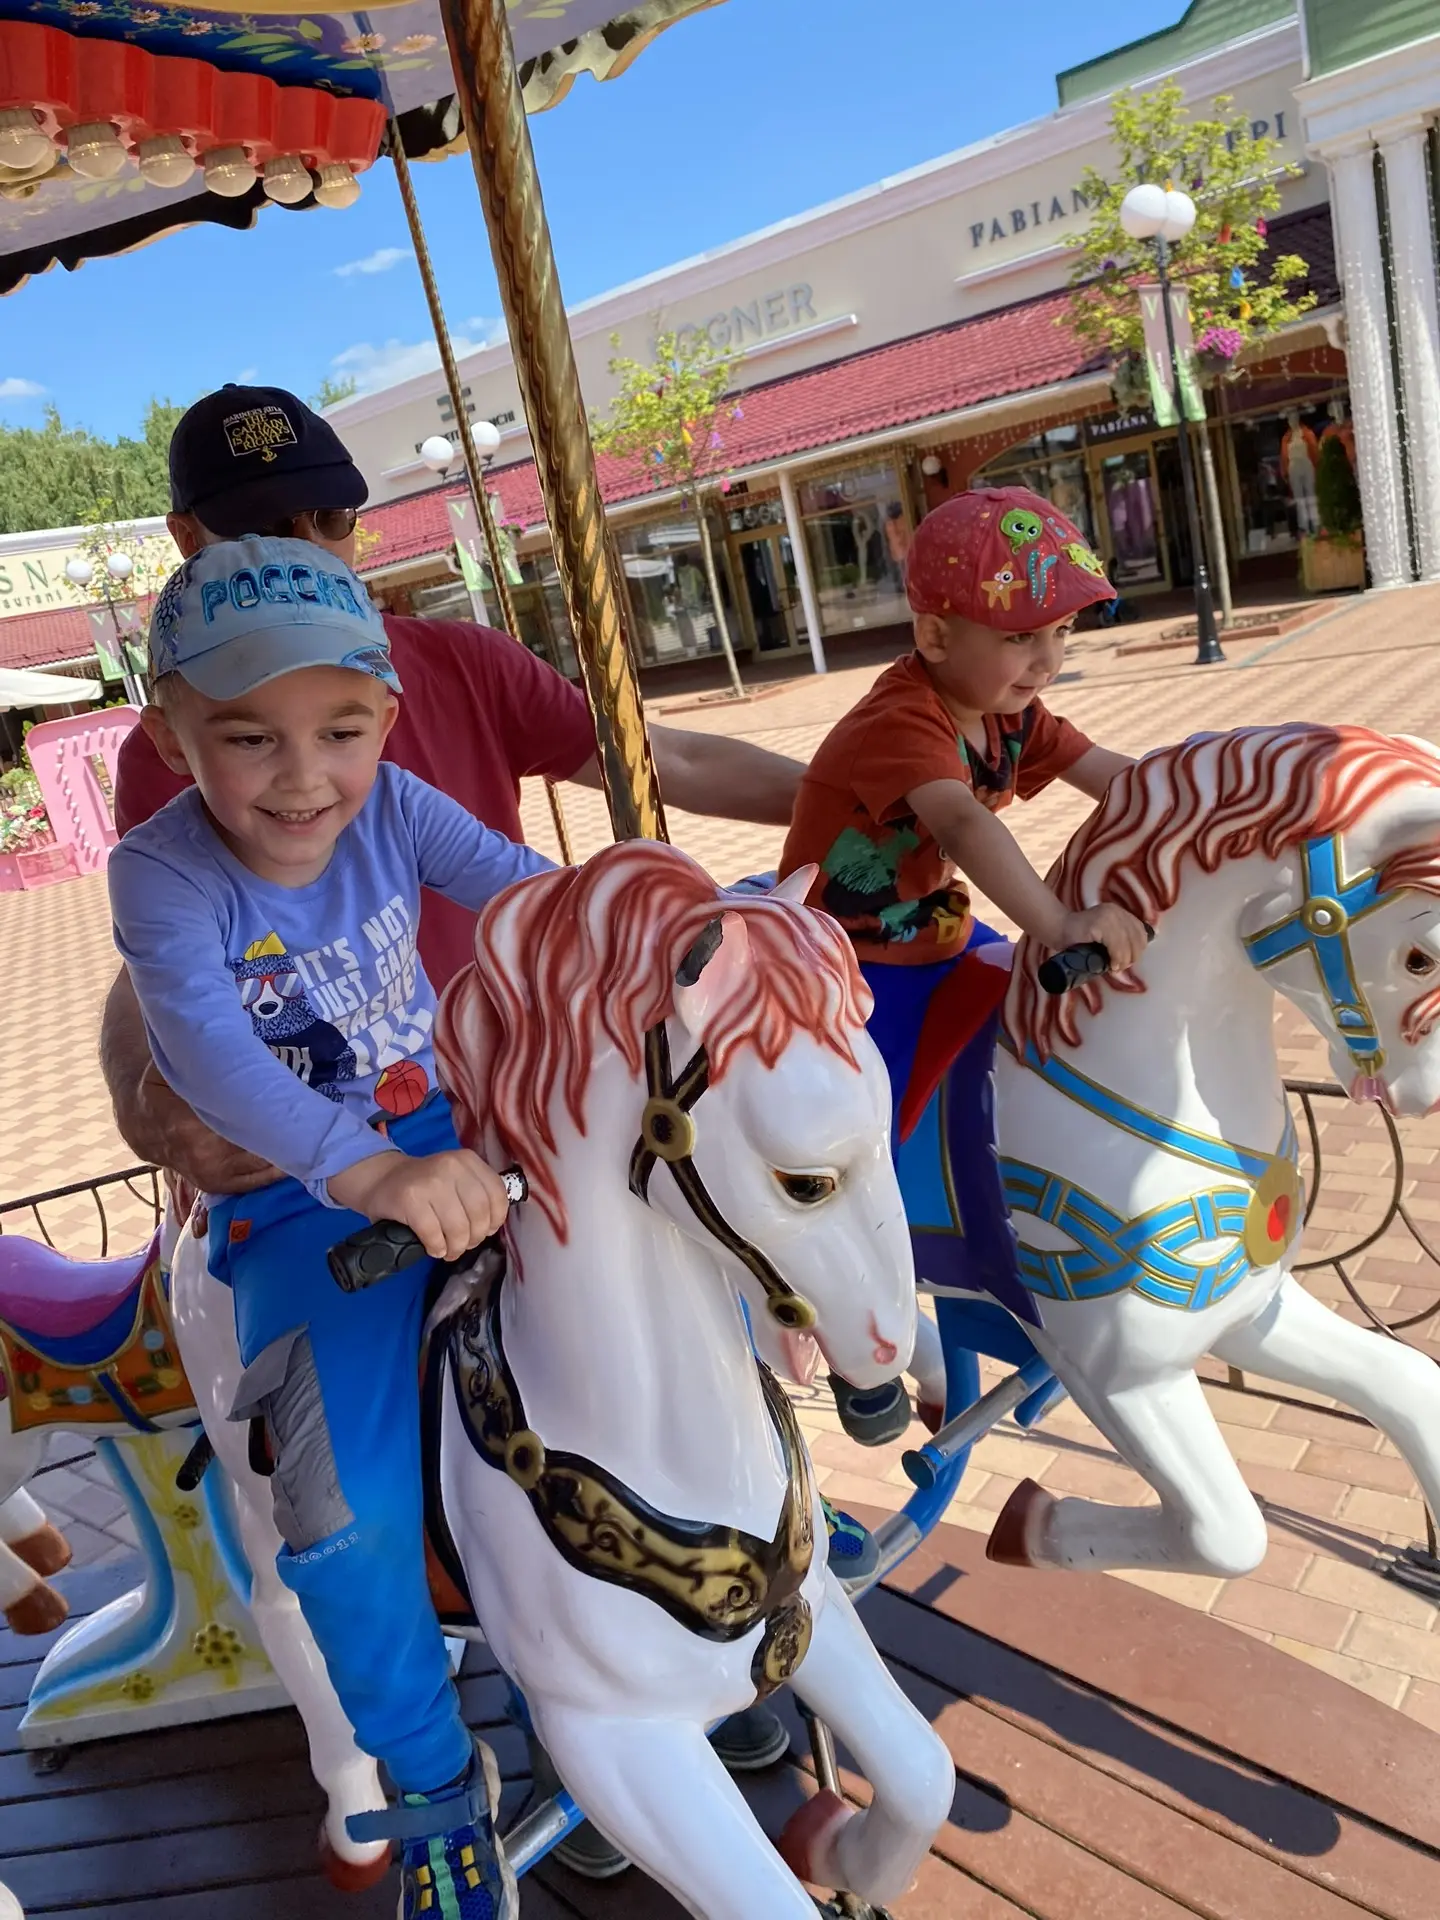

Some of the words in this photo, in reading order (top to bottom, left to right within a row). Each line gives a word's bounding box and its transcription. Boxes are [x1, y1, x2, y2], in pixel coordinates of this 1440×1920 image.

[232, 418, 284, 437] CAPTAIN
[244, 413, 268, 426] THE
[232, 437, 243, 447] IS
[245, 425, 290, 443] ALWAYS
[293, 936, 359, 989] IT'S
[361, 895, 409, 953] NOT
[312, 970, 368, 1023] JUST
